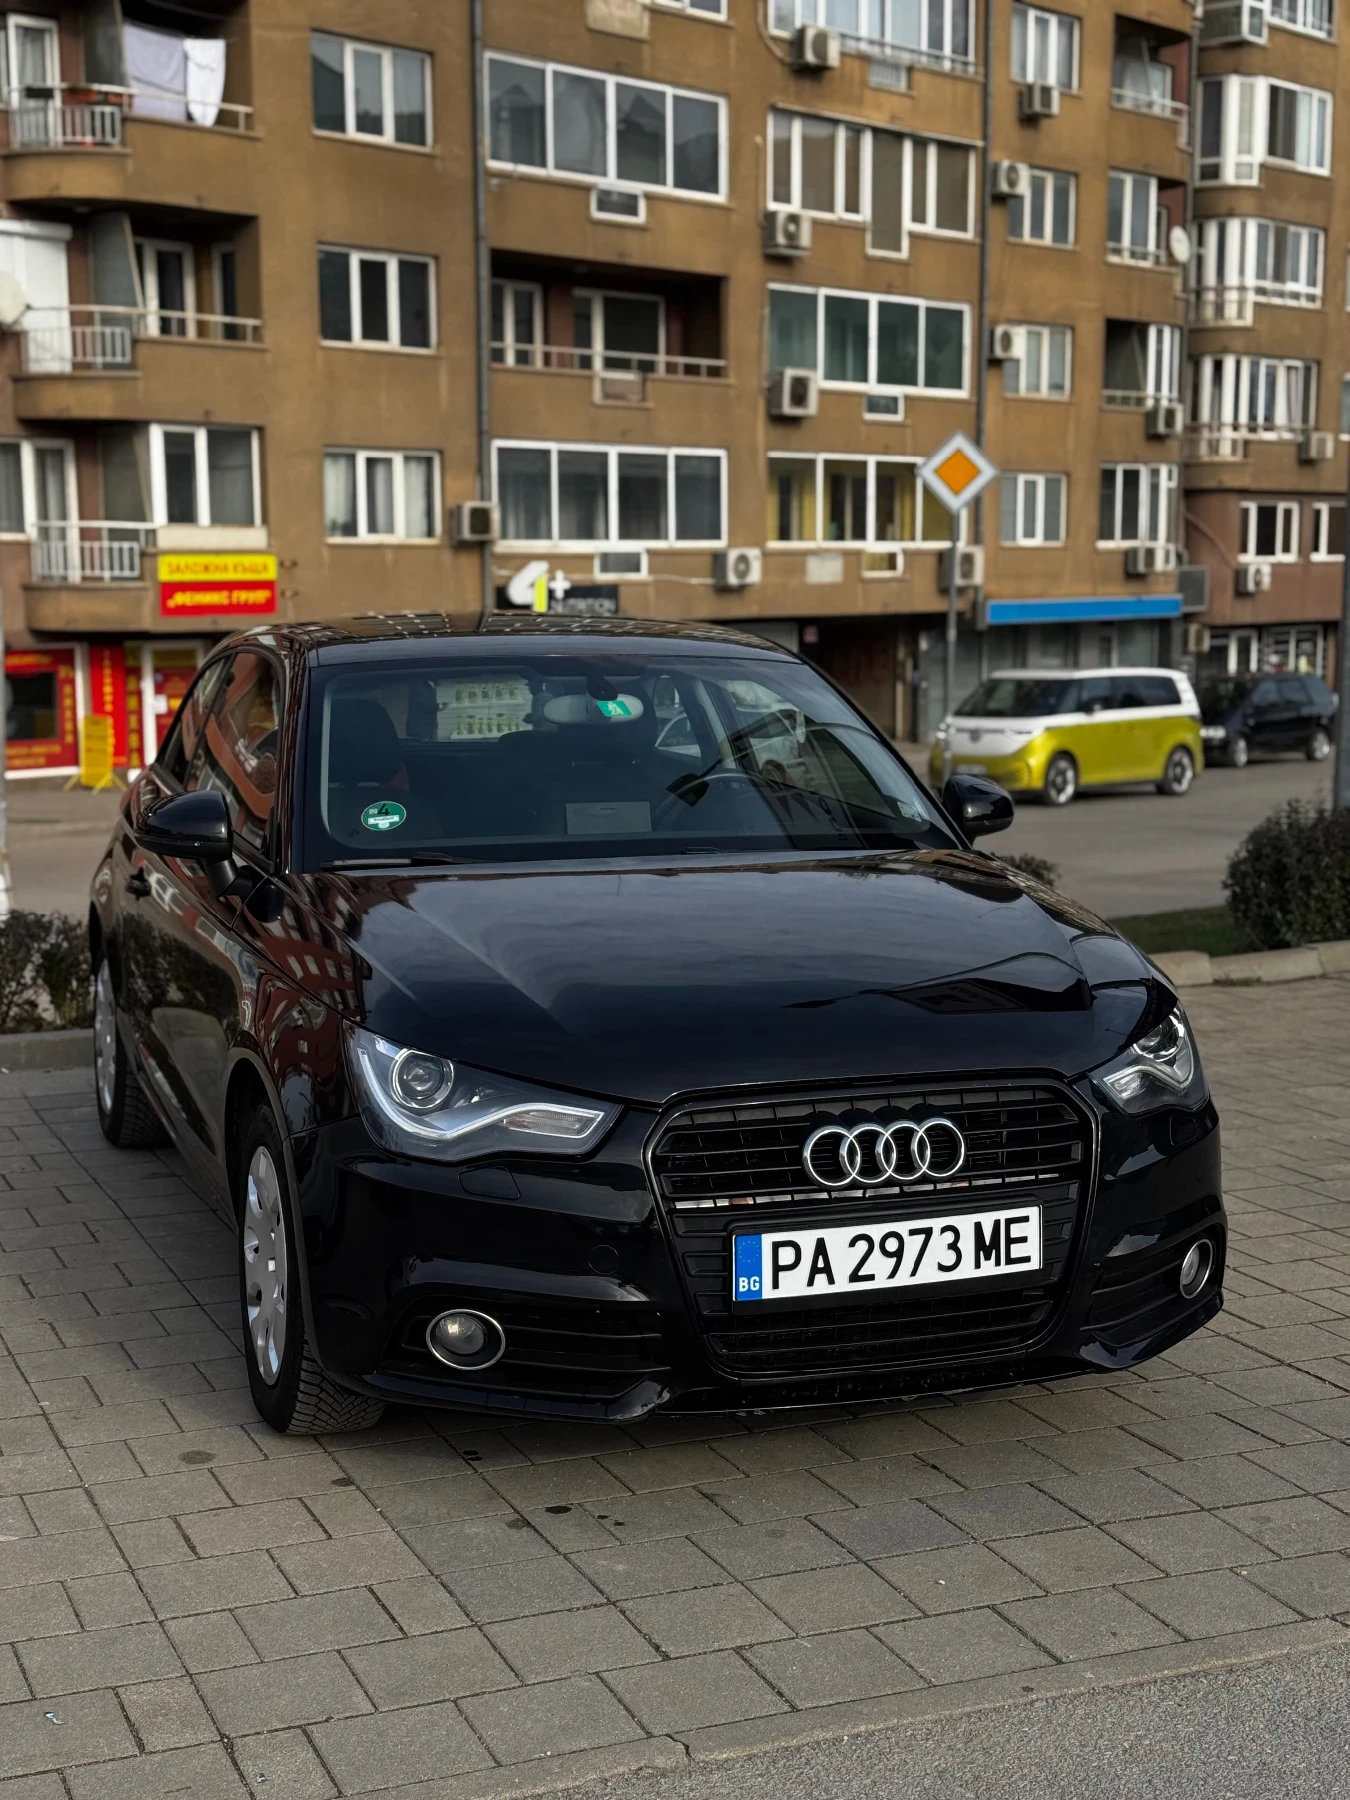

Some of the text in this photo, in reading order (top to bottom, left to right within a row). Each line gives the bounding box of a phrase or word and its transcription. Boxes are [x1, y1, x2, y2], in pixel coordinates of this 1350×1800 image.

[378, 803, 390, 816] 4
[771, 1214, 1032, 1290] PA 2973 ME
[738, 1276, 760, 1292] BG
